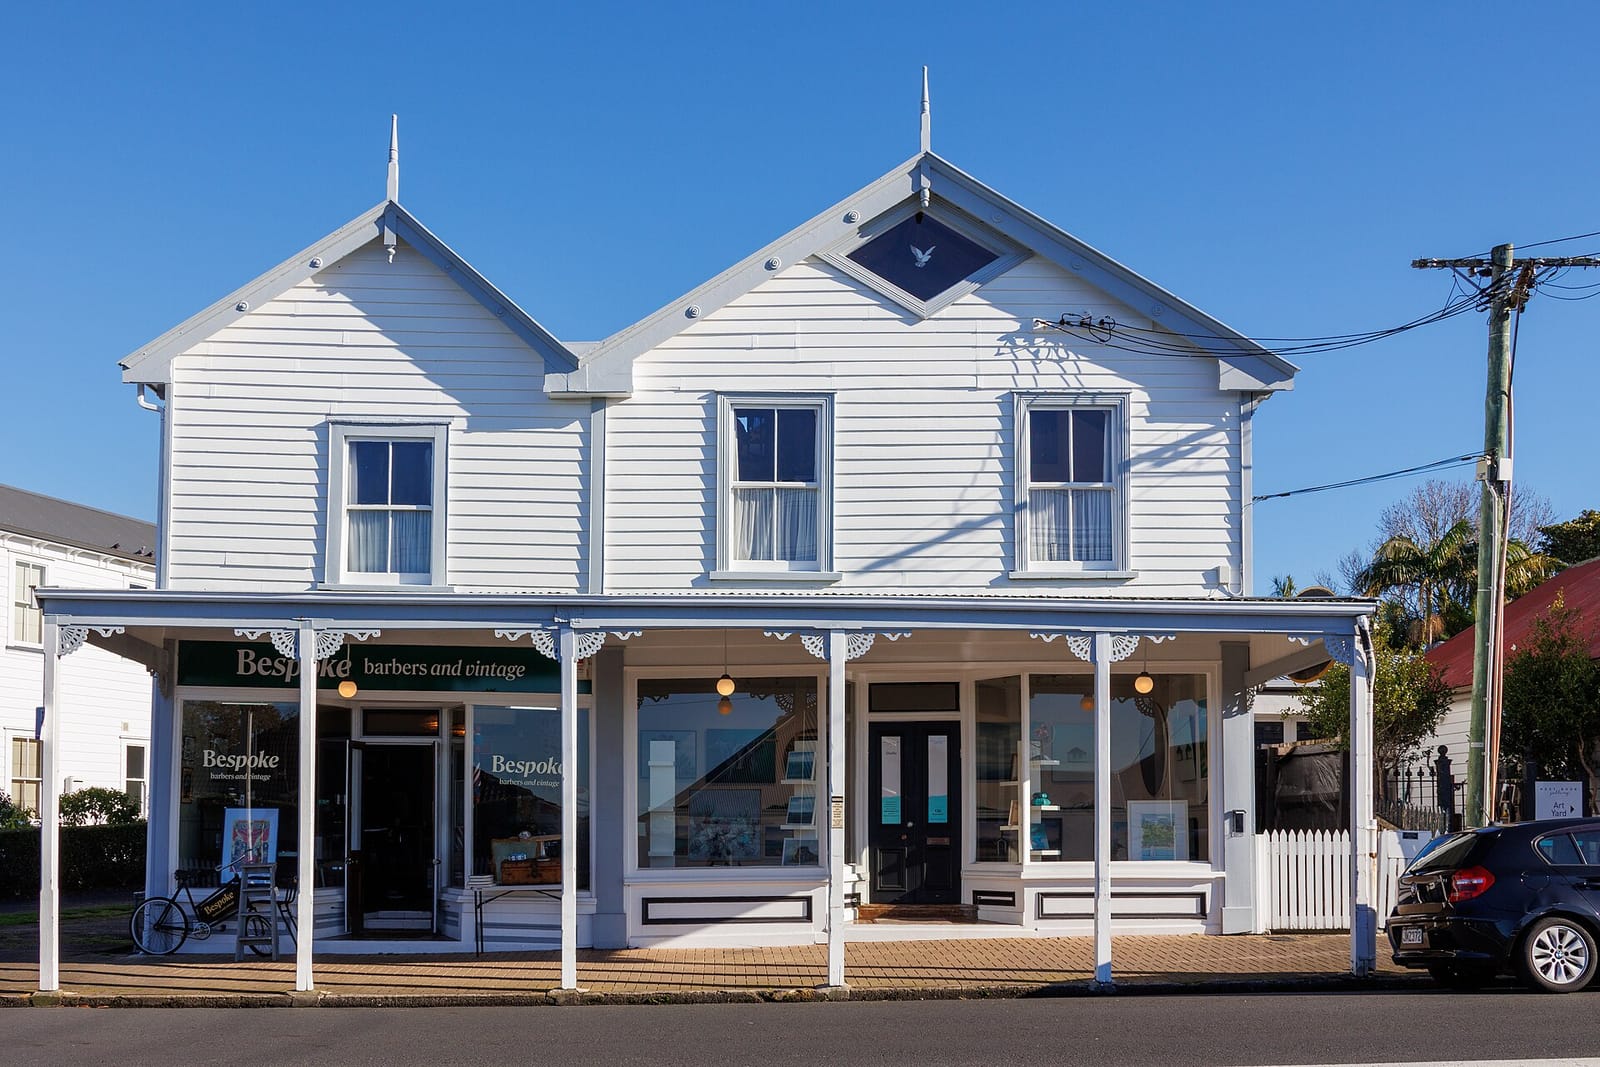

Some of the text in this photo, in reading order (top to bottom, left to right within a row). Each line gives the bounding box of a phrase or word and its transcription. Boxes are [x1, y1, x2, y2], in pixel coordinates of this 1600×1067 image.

[236, 649, 352, 682] Bespke
[364, 658, 526, 681] barbers and vintage
[202, 749, 280, 771] Bespoke
[210, 772, 234, 780] barbers
[499, 778, 523, 786] barbers
[537, 780, 560, 788] vintage
[203, 891, 235, 915] Bespoke
